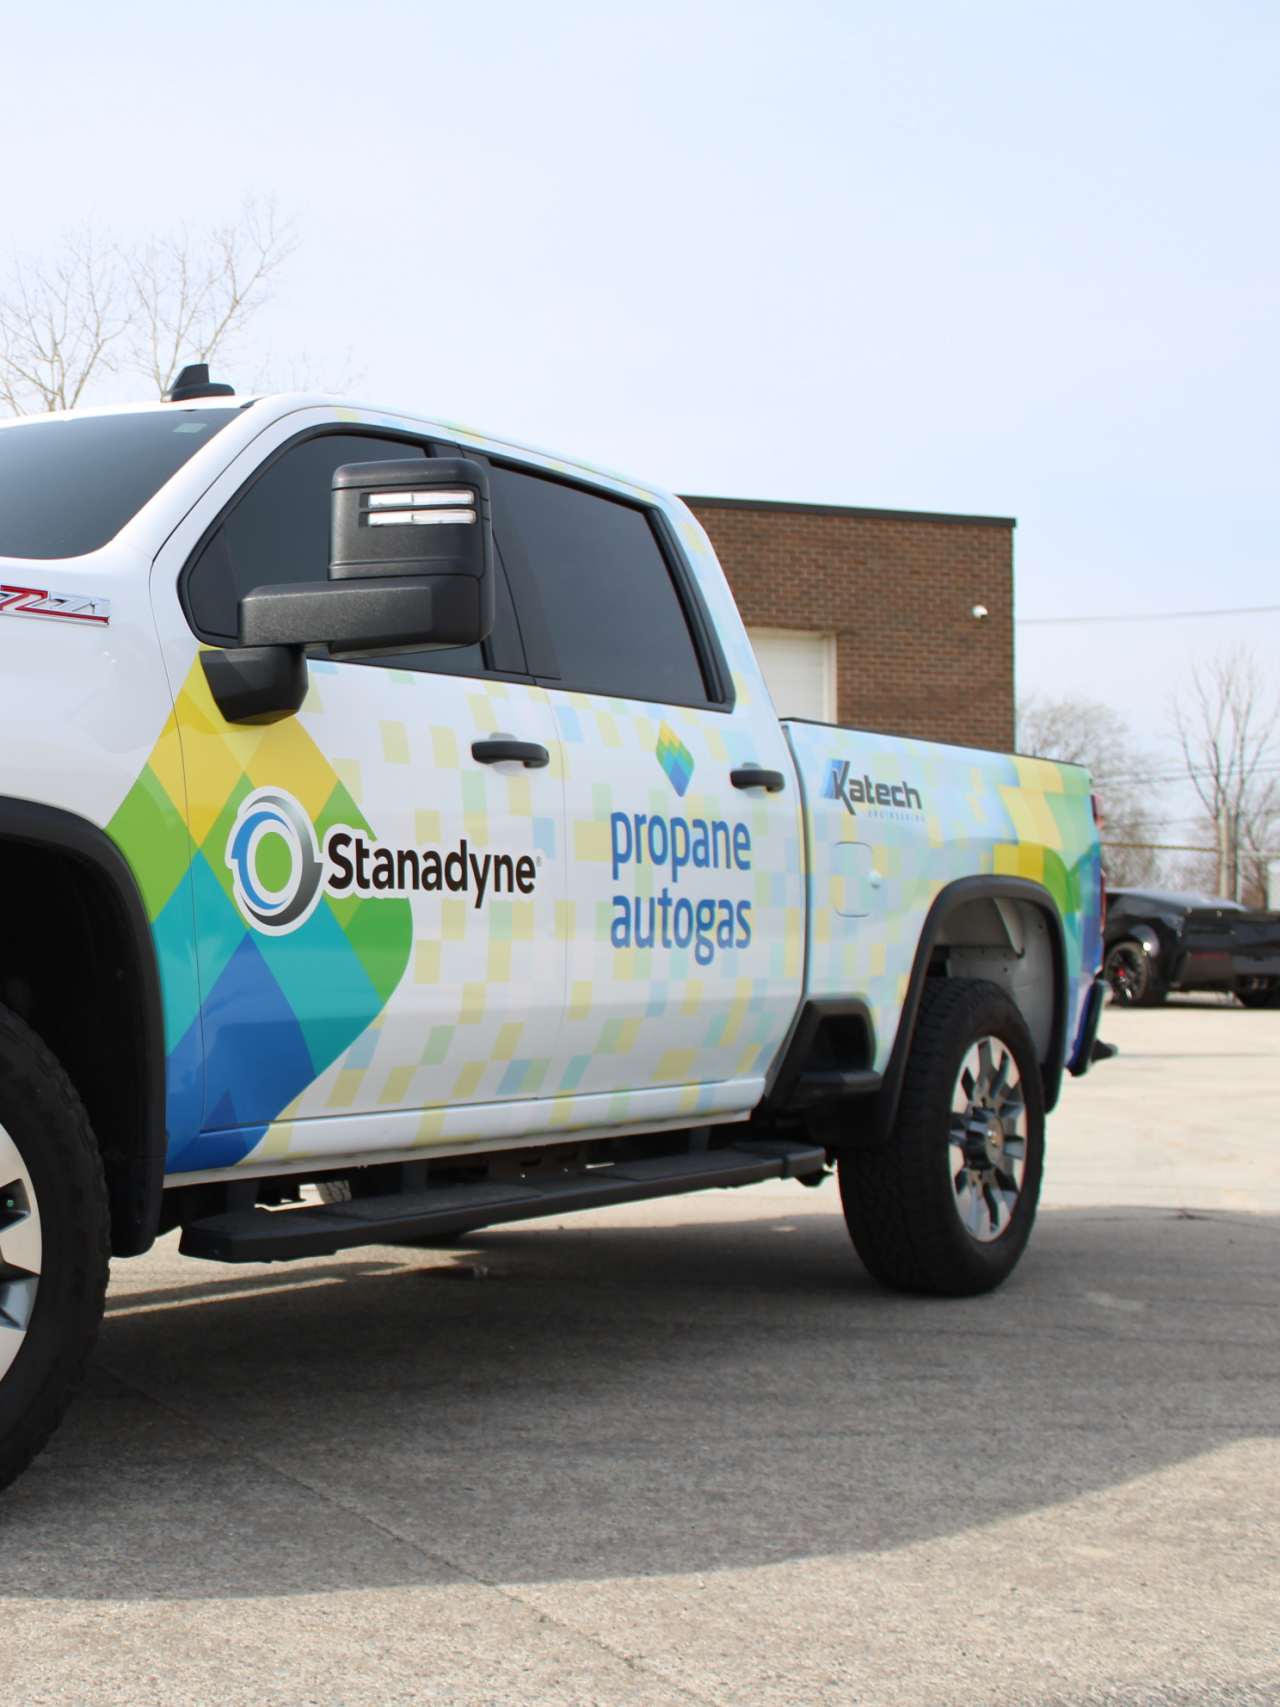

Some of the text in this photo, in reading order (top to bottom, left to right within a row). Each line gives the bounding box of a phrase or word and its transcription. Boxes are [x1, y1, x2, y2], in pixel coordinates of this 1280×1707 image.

[831, 760, 922, 815] Katech
[328, 832, 536, 909] Stanadyne
[611, 811, 751, 883] propane
[611, 888, 751, 966] autogas
